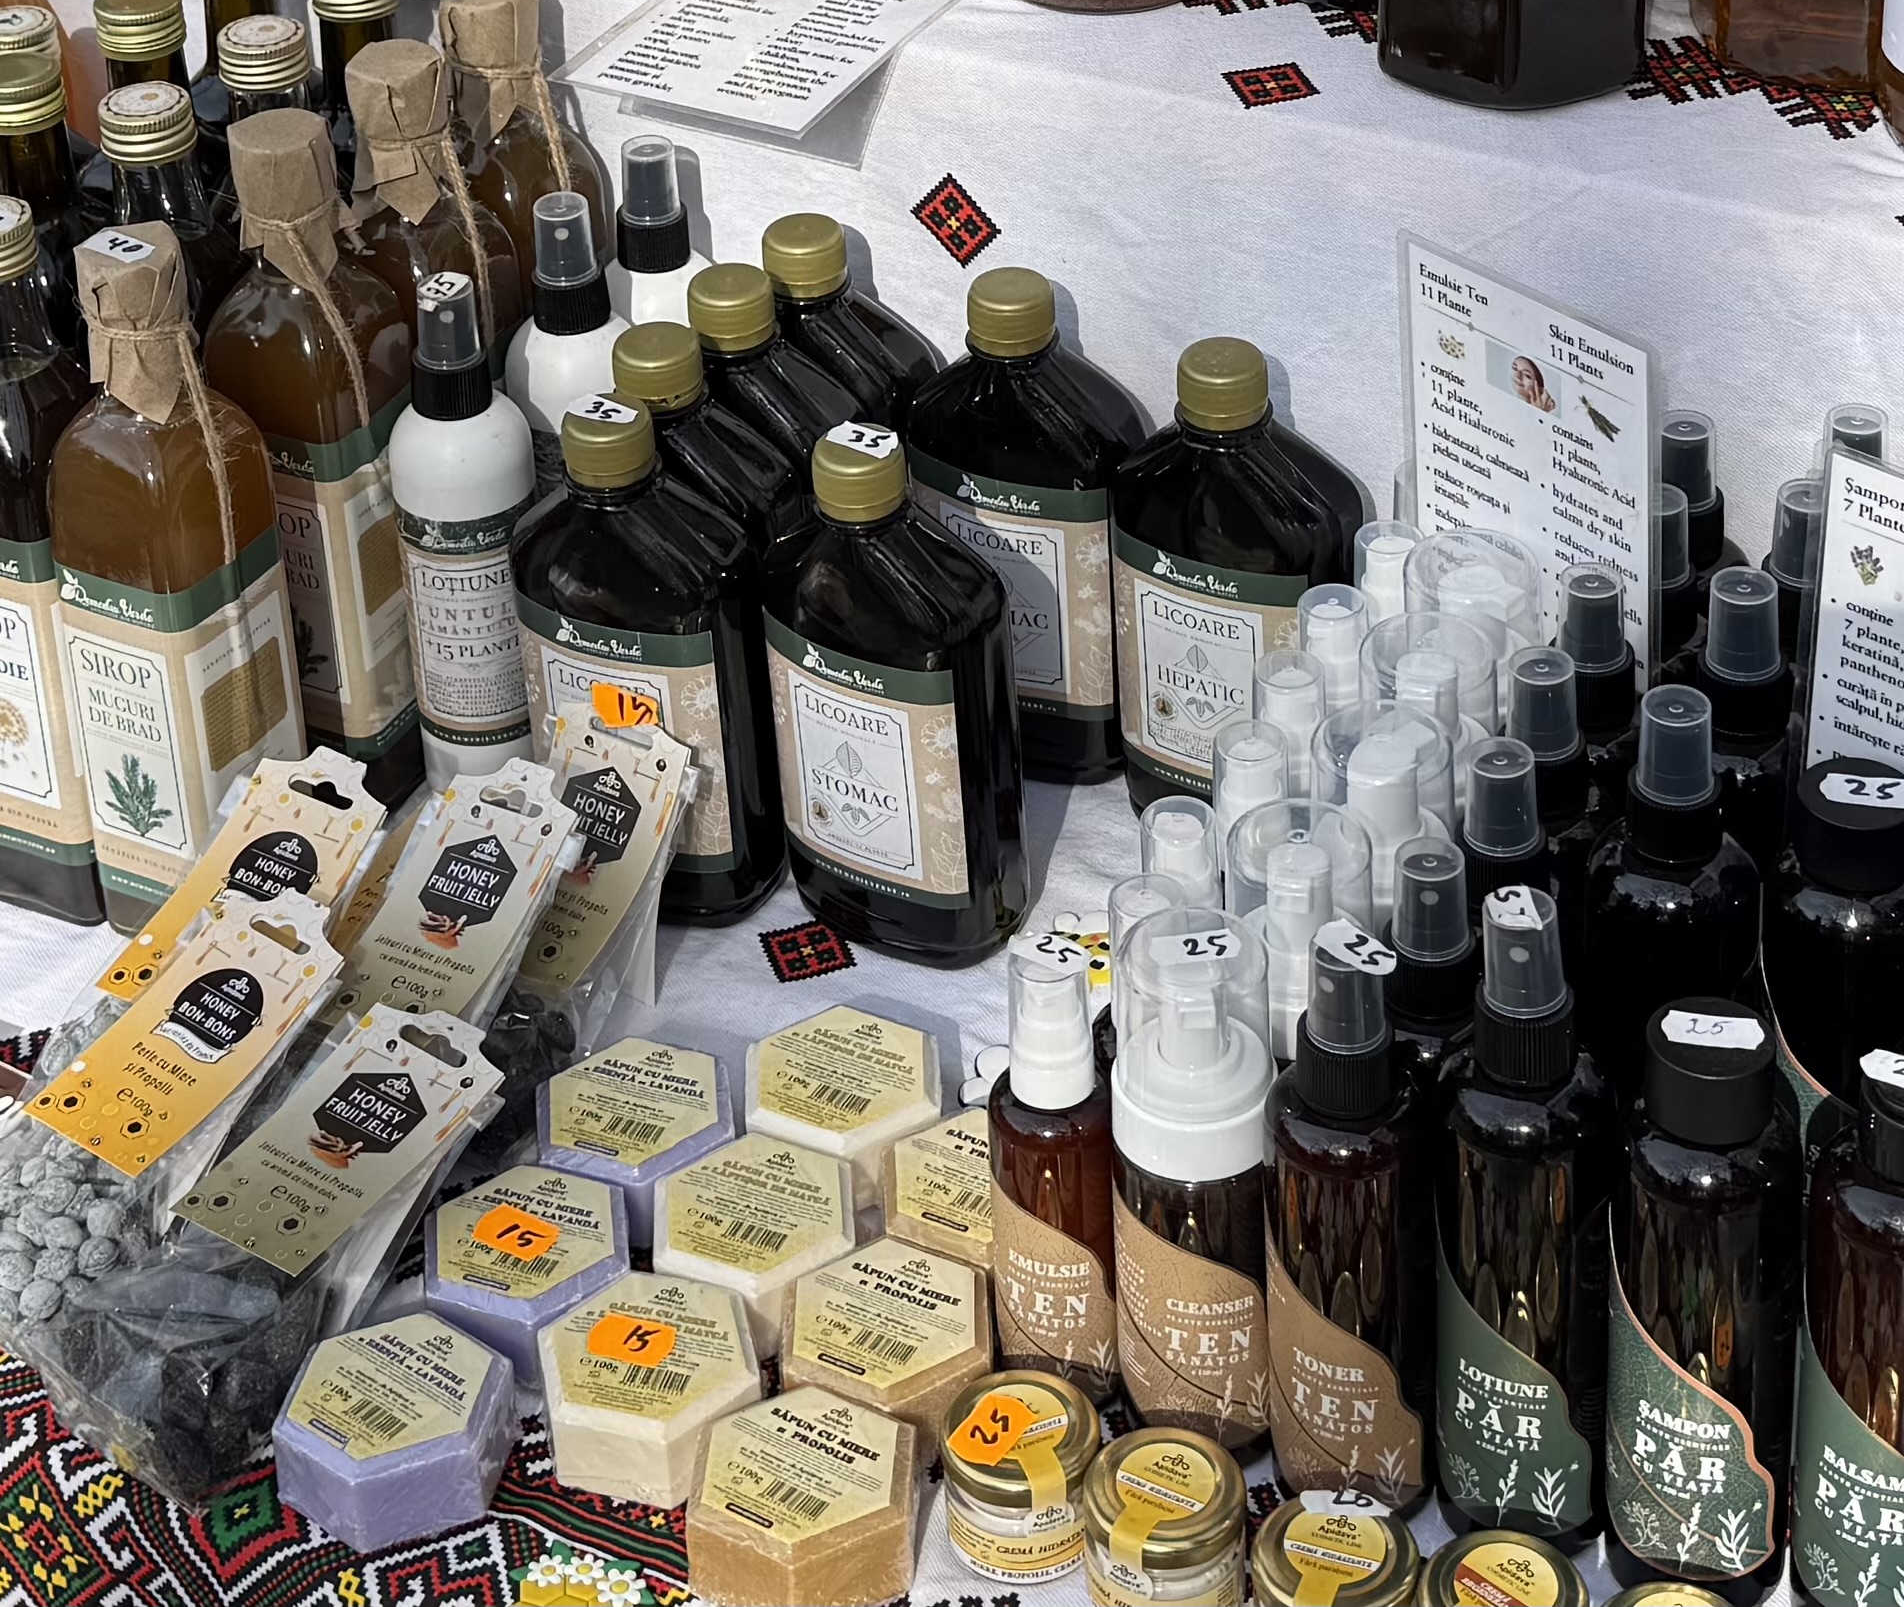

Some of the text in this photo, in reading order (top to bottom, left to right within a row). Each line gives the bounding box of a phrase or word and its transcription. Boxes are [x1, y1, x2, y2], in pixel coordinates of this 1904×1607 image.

[1419, 263, 1489, 307] Emulsie Ten
[1421, 283, 1472, 317] 11 Plante
[1549, 323, 1634, 375] Skin Emulsion
[1549, 344, 1604, 380] 11 Plants
[583, 399, 618, 420] 35
[847, 428, 887, 451] 35
[1552, 422, 1594, 451] contains
[1843, 498, 1853, 513] 7
[1552, 505, 1632, 553] calms dry skin
[1152, 599, 1240, 642] LICOARE
[80, 648, 151, 689] SIROP
[1156, 662, 1245, 706] HEPATIC
[88, 686, 156, 722] MUGURI
[803, 692, 890, 738] LICOARE
[88, 706, 162, 743] DE BRAD
[811, 768, 899, 813] STOMAC
[1844, 777, 1902, 801] 25
[427, 873, 500, 910] FRUIT JELLY
[445, 858, 500, 890] HONEY
[1032, 934, 1082, 967] 25
[1182, 934, 1232, 961] 25
[1341, 930, 1396, 970] 25
[178, 1000, 237, 1043] BON-BONS
[200, 990, 241, 1022] HONEY
[1682, 1014, 1726, 1040] 25
[324, 1096, 404, 1144] FRUIT JELLY
[347, 1086, 409, 1124] HONEY
[495, 1222, 550, 1250] 15
[1008, 1248, 1090, 1278] EMULSIE
[1006, 1275, 1090, 1318] TEN
[1166, 1295, 1254, 1316] CLEANSER
[1164, 1325, 1253, 1356] TEN
[1292, 1346, 1364, 1382] TONER
[1458, 1358, 1550, 1400] LOȚIUNE
[1291, 1377, 1378, 1422] TEN
[1456, 1386, 1543, 1441] PĂR
[1637, 1398, 1732, 1441] ȘAMPON
[1632, 1428, 1727, 1482] PĂR
